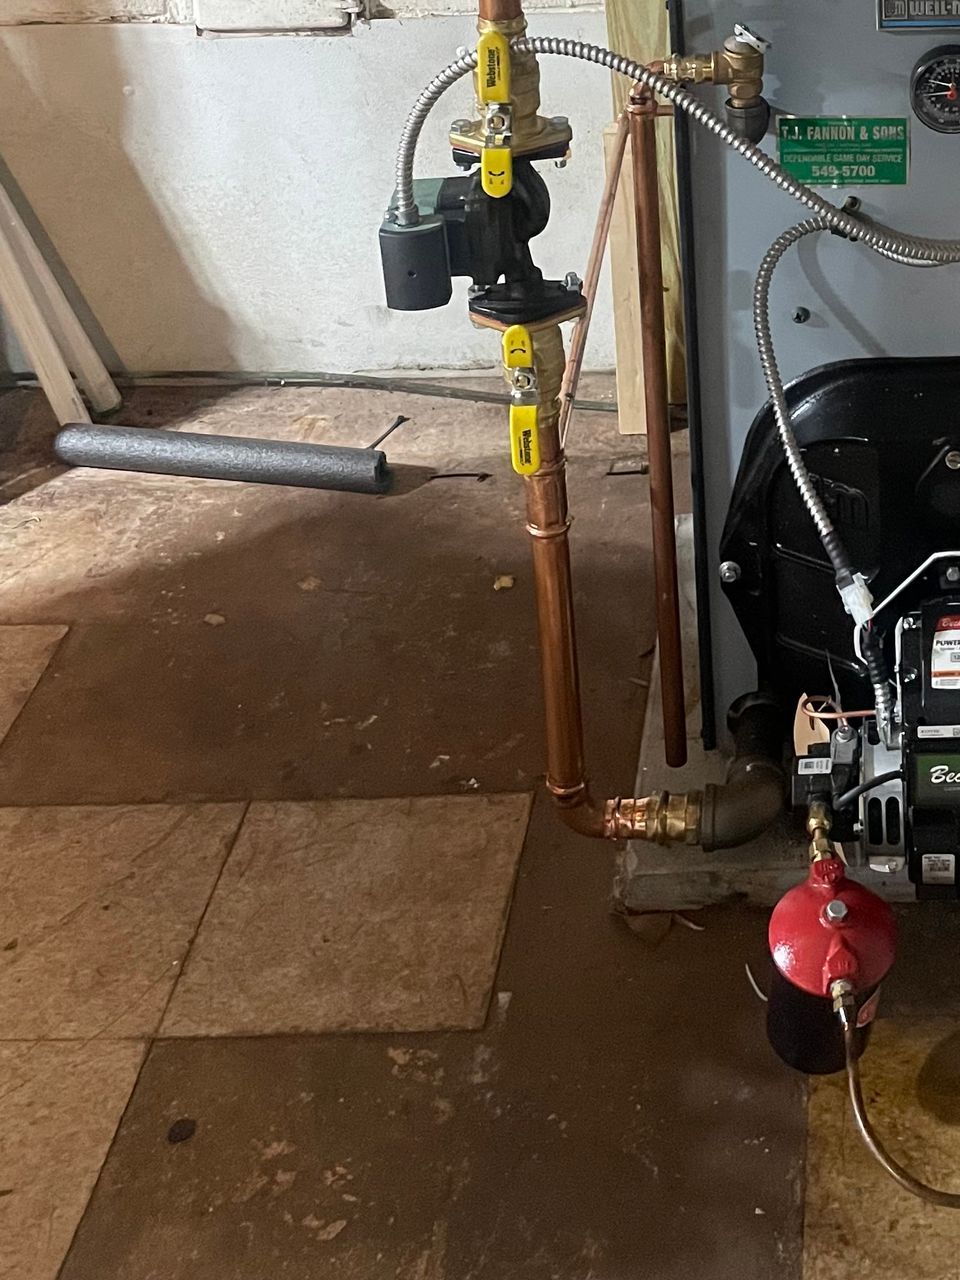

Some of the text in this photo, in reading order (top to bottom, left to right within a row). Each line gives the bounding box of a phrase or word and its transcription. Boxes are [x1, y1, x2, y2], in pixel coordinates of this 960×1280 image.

[486, 48, 497, 89] Webstone
[781, 126, 904, 140] T.J. FANNON & SONS
[833, 154, 854, 162] SAME
[856, 154, 871, 162] DAY
[872, 154, 903, 163] SERVICE
[811, 165, 875, 177] 549-5700
[521, 429, 532, 464] Webstone
